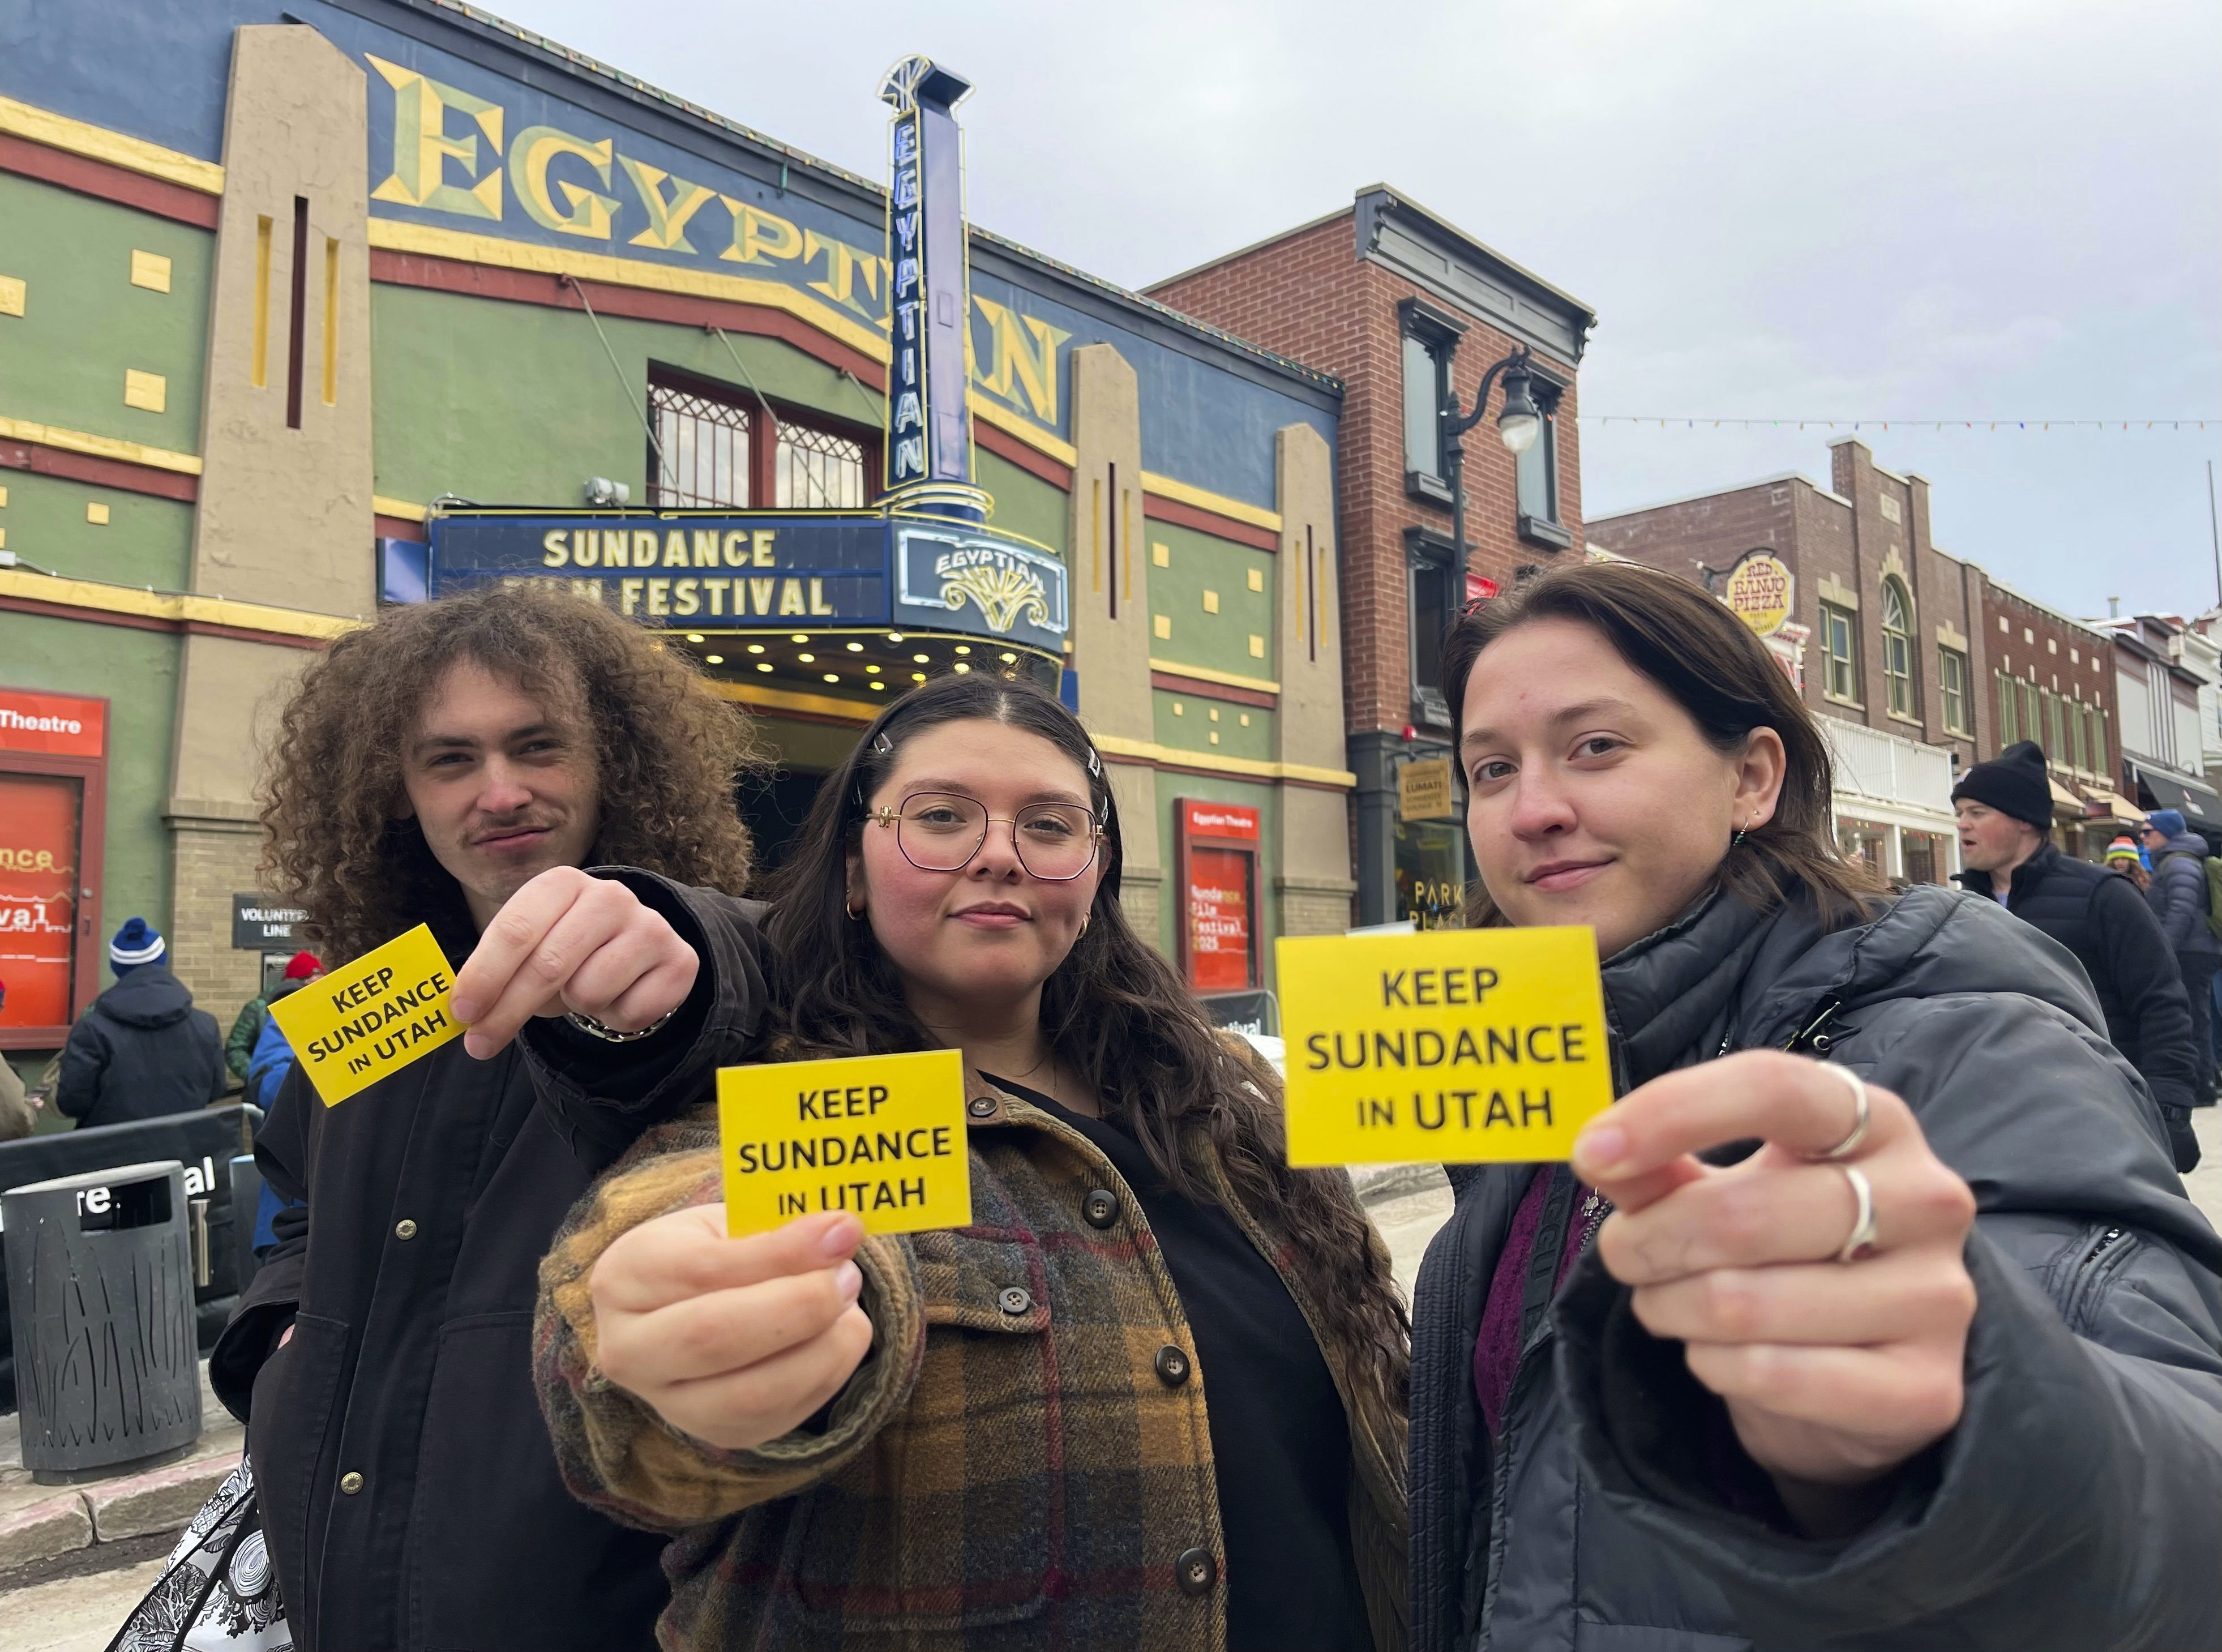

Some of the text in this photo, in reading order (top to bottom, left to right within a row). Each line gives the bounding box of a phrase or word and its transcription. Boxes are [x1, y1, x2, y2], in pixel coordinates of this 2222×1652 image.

[363, 52, 1073, 426] EGYPTN
[894, 124, 924, 479] EGYPTIAN
[542, 529, 776, 568] SUNDANCE
[936, 549, 1044, 593] EGYPTIAN
[1734, 577, 1786, 594] BANJO
[1746, 563, 1773, 576] RED
[622, 576, 832, 617] FESTIVAL
[1733, 594, 1785, 611] PIZZA
[0, 709, 82, 734] Theatre
[1406, 781, 1442, 793] LUMATI
[1225, 814, 1253, 828] Theatre
[1415, 881, 1463, 906] PARK
[263, 924, 292, 937] LINE
[332, 967, 393, 1014] KEEP
[1381, 966, 1499, 1007] KEEP
[307, 971, 449, 1063] SUNDANCE
[348, 1009, 448, 1075] IN UTAH
[1307, 1024, 1586, 1071] SUNDANCE
[799, 1086, 888, 1120] KEEP
[1359, 1089, 1554, 1130] IN UTAH
[739, 1127, 952, 1174] SUNDANCE
[778, 1176, 926, 1217] IN UTAH
